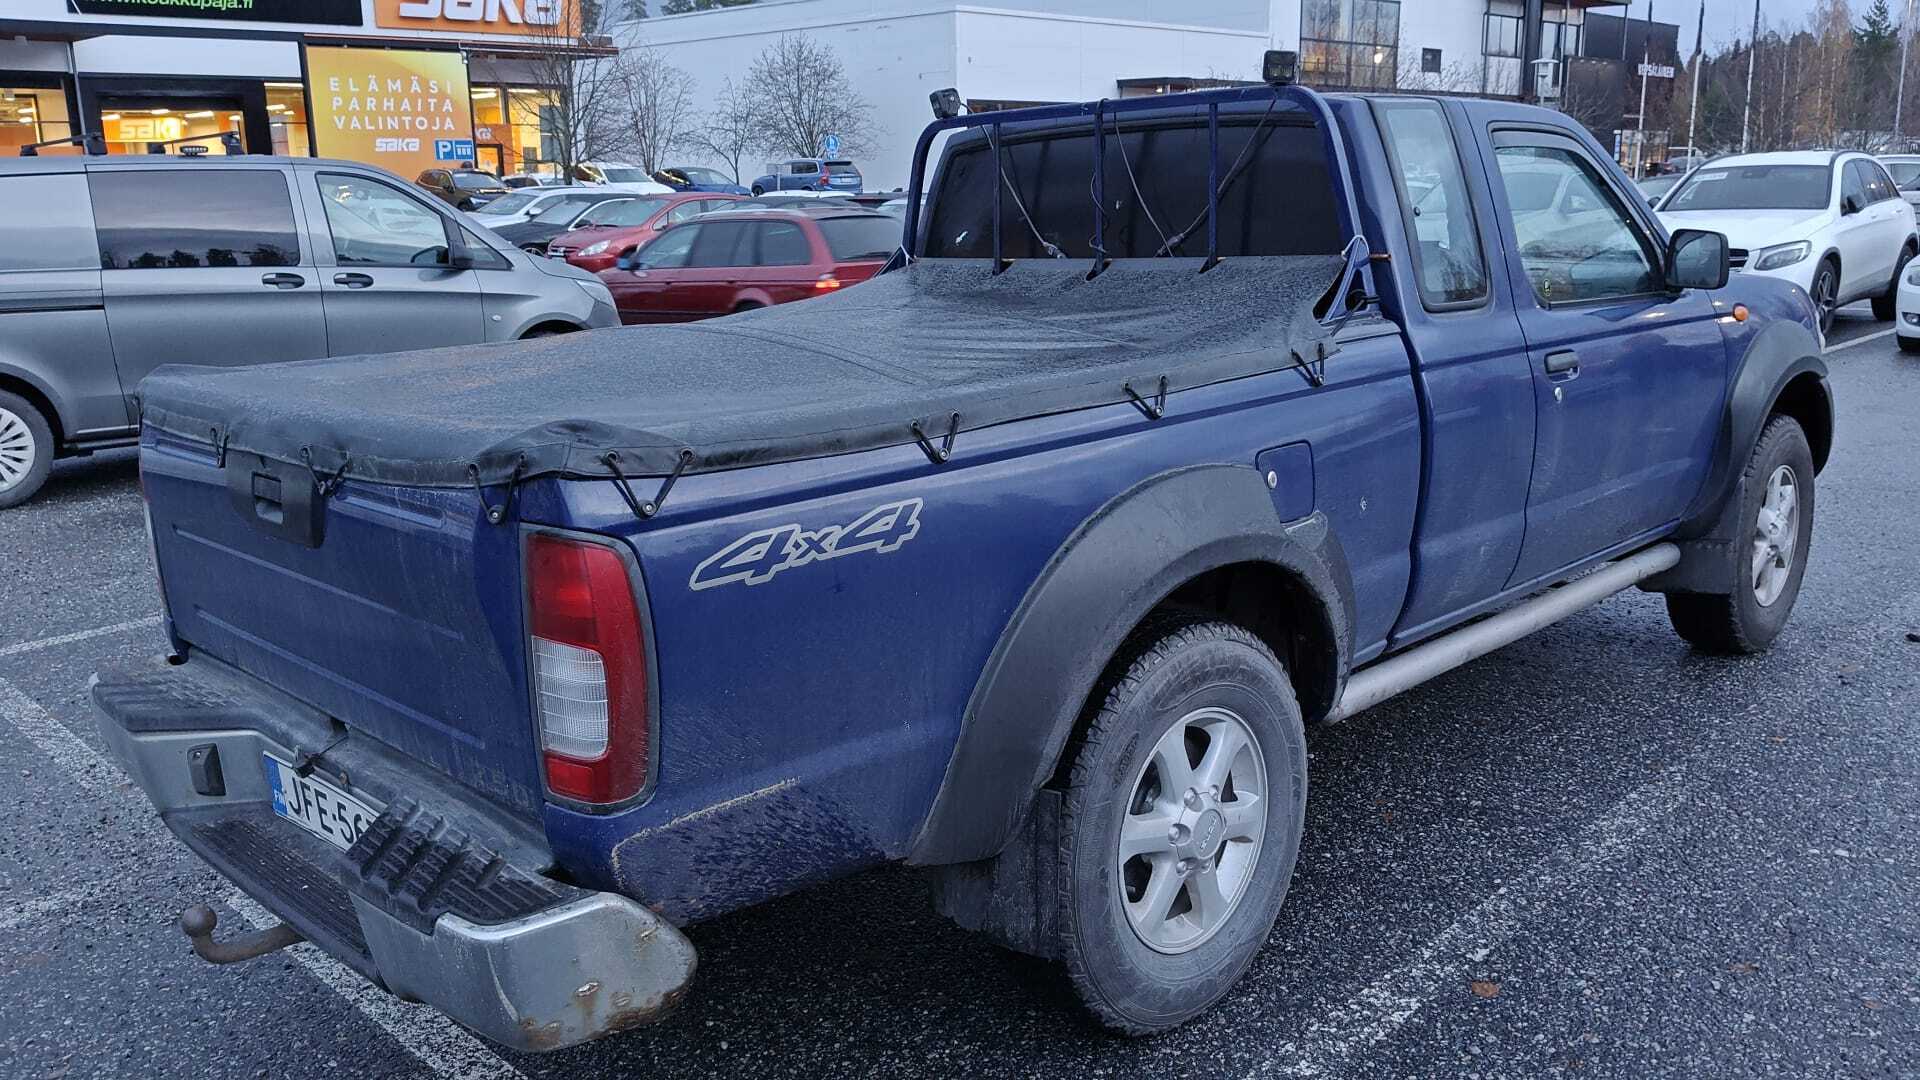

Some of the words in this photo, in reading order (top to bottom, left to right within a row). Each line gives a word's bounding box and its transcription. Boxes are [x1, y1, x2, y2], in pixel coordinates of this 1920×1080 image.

[329, 75, 451, 94] ELÄMÄSI
[332, 96, 453, 113] PARHAITA
[334, 115, 456, 130] VALINTOJA
[439, 141, 451, 160] P
[689, 498, 923, 591] 4x4
[288, 777, 373, 844] JFE-56
